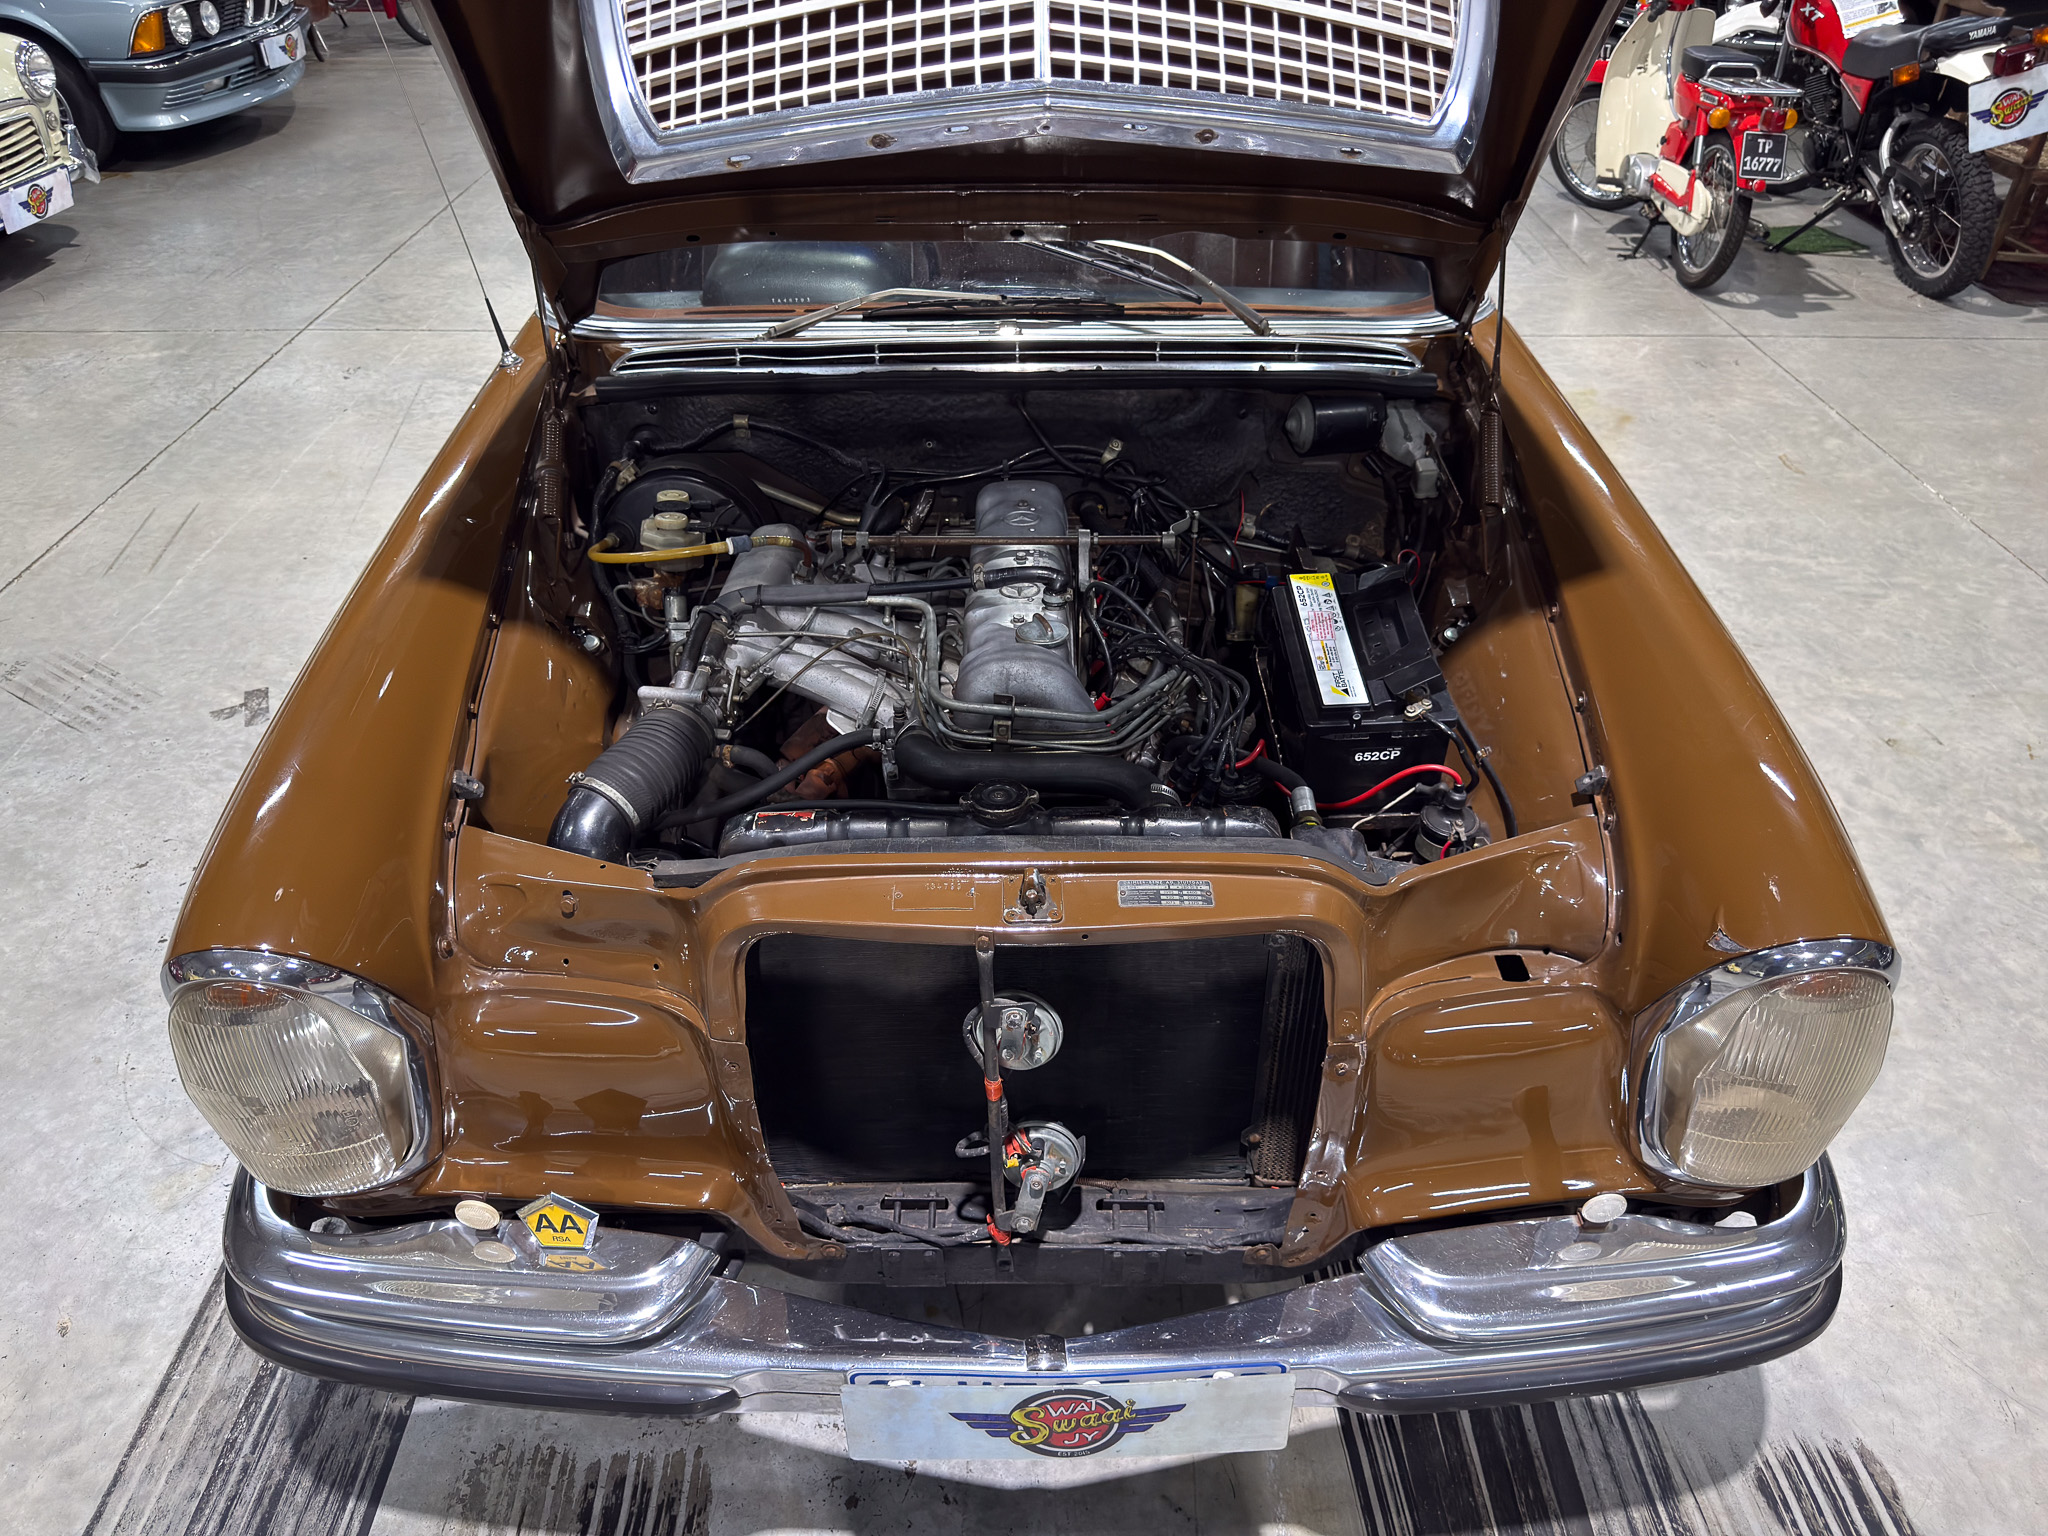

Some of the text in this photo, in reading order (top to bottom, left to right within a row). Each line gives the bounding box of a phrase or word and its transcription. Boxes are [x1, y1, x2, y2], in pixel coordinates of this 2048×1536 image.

[1800, 2, 1825, 22] XT
[1968, 25, 1997, 40] YAMAHA
[1757, 139, 1773, 153] TP
[1743, 156, 1782, 172] 16777
[1296, 585, 1307, 607] 652CP
[1354, 751, 1400, 762] 652CP
[535, 1214, 584, 1234] AA
[1047, 1396, 1109, 1417] WAT
[1009, 1398, 1137, 1445] Swaai
[1064, 1430, 1100, 1445] JY
